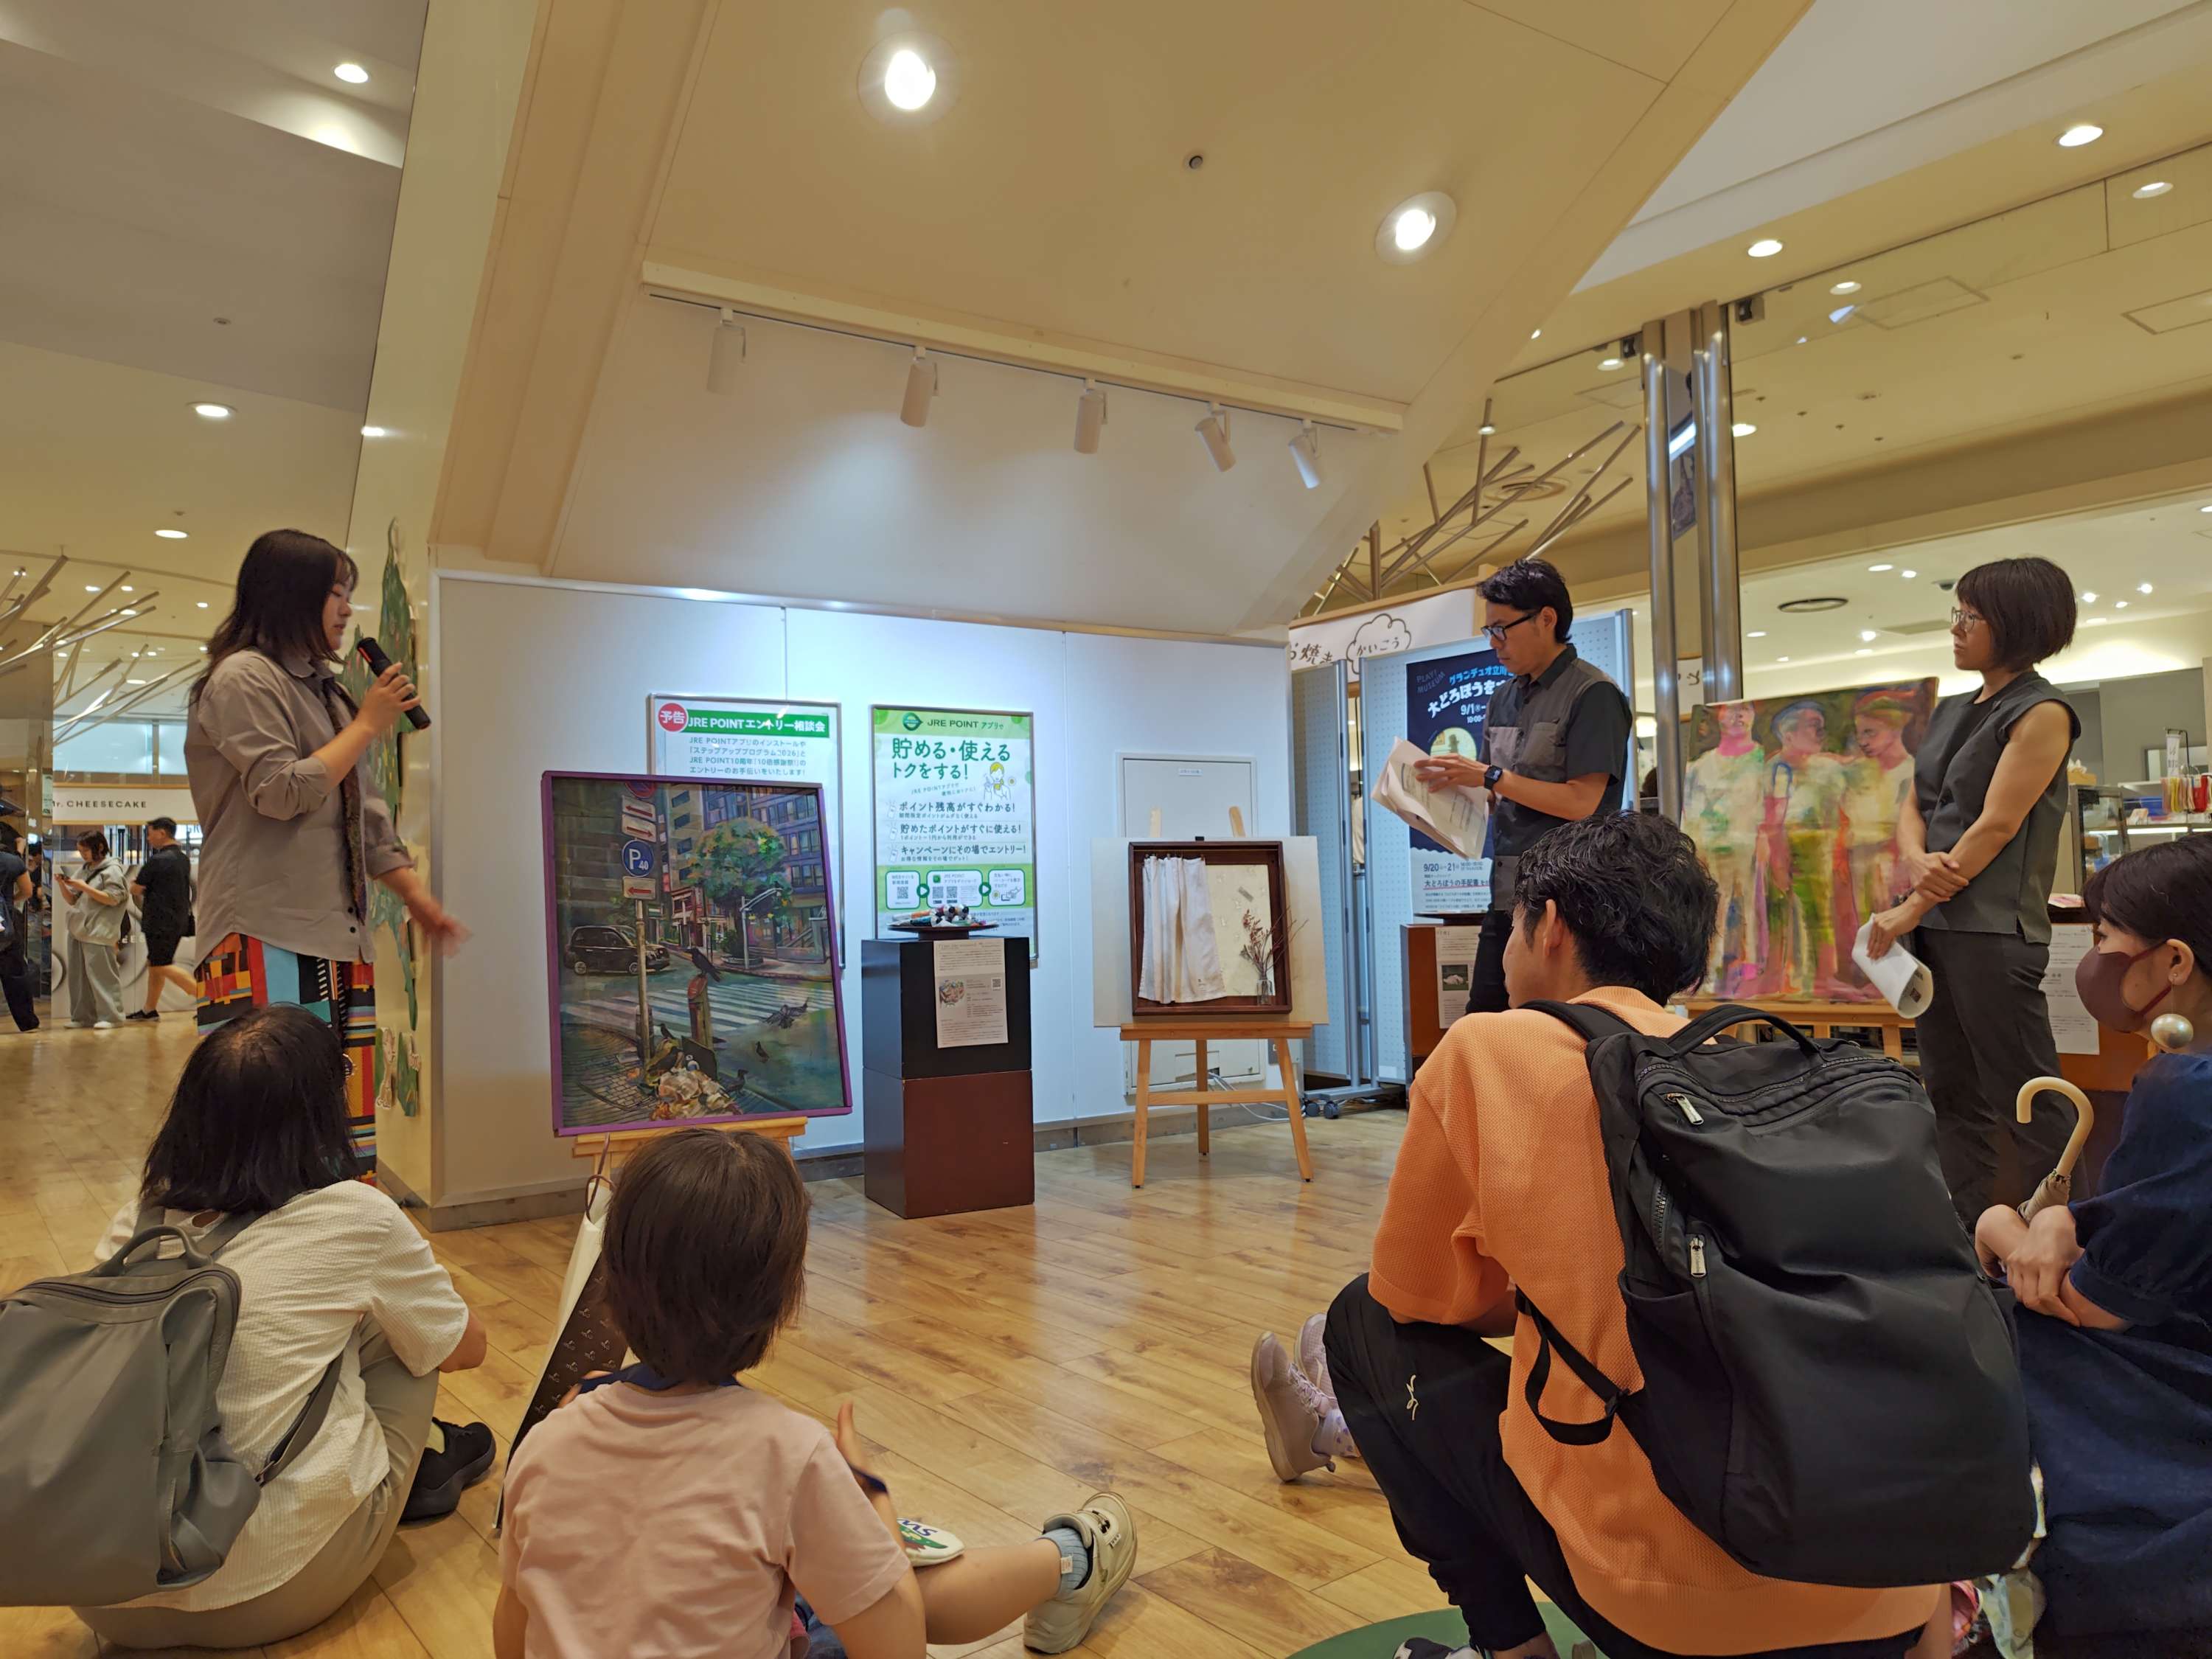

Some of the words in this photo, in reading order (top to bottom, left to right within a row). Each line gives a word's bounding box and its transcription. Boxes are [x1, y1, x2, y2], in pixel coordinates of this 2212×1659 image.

[1449, 665, 1515, 685] グランデュオ立川
[660, 711, 685, 725] 予告
[688, 717, 708, 728] JRE
[928, 719, 947, 727] JRE
[949, 720, 979, 728] POINT
[891, 738, 1010, 762] 貯める・使える
[690, 757, 703, 765] JRE
[893, 762, 968, 779] トクをする!
[629, 849, 641, 870] P
